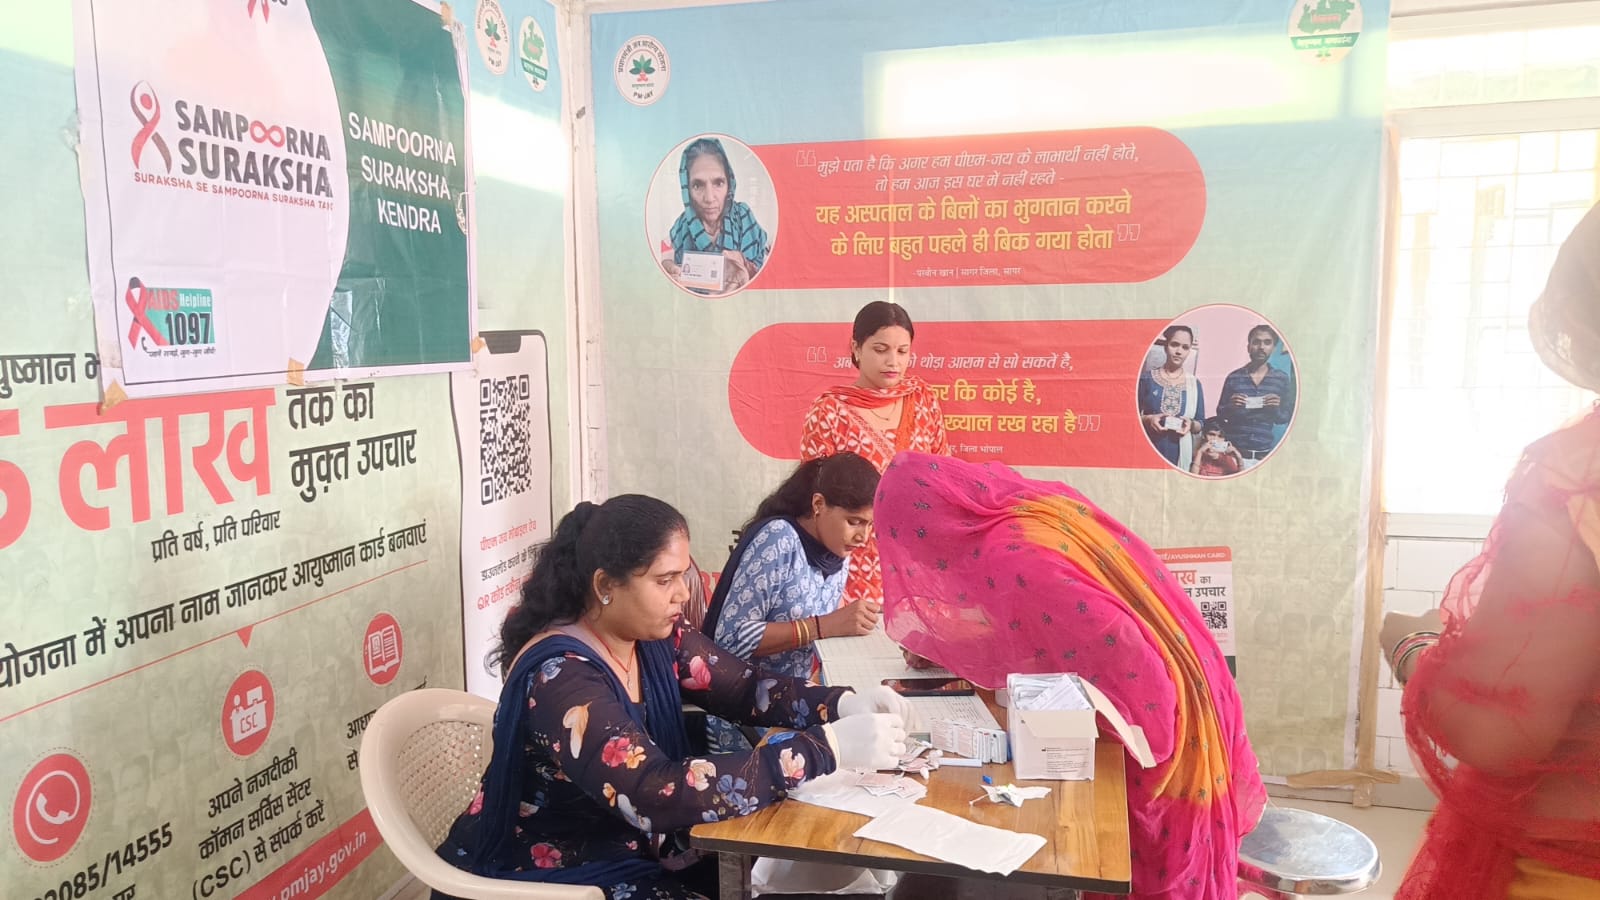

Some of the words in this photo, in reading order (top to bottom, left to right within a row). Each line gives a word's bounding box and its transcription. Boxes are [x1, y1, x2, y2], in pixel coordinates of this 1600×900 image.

[348, 112, 457, 166] SAMPOORNA
[178, 138, 333, 198] SURAKSHA
[817, 156, 841, 177] मुझे
[843, 159, 863, 173] पता
[866, 153, 876, 172] है
[878, 154, 896, 172] कि
[899, 156, 929, 170] अगर
[931, 155, 952, 169] हम
[954, 150, 1014, 168] पीएम-जय
[1017, 147, 1032, 165] के
[1035, 144, 1083, 164] लाभार्थी
[1112, 141, 1139, 163] होते,
[134, 172, 193, 190] SURAKSHA
[196, 181, 208, 193] SE
[212, 184, 270, 201] SAMPOORNA
[272, 193, 315, 208] SURAKSHA
[361, 155, 451, 200] SURAKSHA
[875, 174, 889, 192] तो
[891, 177, 911, 191] हम
[914, 176, 940, 190] आज
[944, 174, 963, 190] इस
[967, 174, 984, 188] घर
[986, 170, 1000, 187] में
[1029, 167, 1057, 185] रहते
[377, 198, 442, 234] KENDRA
[815, 206, 841, 225] यह
[845, 203, 914, 223] अस्पताल
[918, 196, 937, 222] के
[941, 194, 980, 221] बिलों
[984, 199, 1009, 219] का
[1013, 197, 1081, 224] भुगतान
[1085, 188, 1132, 215] करने
[831, 231, 849, 256] के
[853, 230, 885, 256] लिए
[889, 235, 924, 261] बहुत
[928, 228, 968, 255] पहले
[972, 227, 989, 254] ही
[994, 226, 1031, 252] बिक
[1035, 231, 1073, 251] गया
[1077, 223, 1114, 250] होता
[180, 293, 211, 308] Helpline
[165, 312, 211, 346] 1097
[920, 352, 945, 371] थोड़ा
[948, 355, 984, 369] आराम
[988, 352, 1001, 369] से
[1003, 352, 1019, 369] सो
[286, 386, 336, 429] तक
[342, 382, 375, 421] का
[954, 378, 978, 401] कि
[982, 377, 1019, 405] कोई
[1022, 377, 1042, 405] है,
[943, 414, 993, 432] ख्याल
[997, 415, 1028, 433] रख
[1031, 415, 1060, 433] रहा
[1063, 408, 1078, 434] है
[44, 387, 277, 531] लाख
[357, 429, 417, 475] उपचार
[151, 529, 179, 563] प्रति
[182, 521, 210, 552] वर्ष,
[213, 515, 237, 546] प्रति
[241, 509, 281, 537] परिवार
[83, 616, 107, 656] में
[114, 603, 175, 648] अपना
[180, 588, 220, 625] नाम
[224, 567, 288, 608] जानकर
[292, 545, 355, 587] आयुष्मान
[359, 527, 385, 563] कार्ड
[387, 518, 427, 552] बनवाएं
[1194, 586, 1226, 598] उपचार
[1200, 575, 1211, 585] का
[477, 594, 490, 610] QR
[240, 711, 258, 734] CSC
[208, 777, 243, 818] अपने
[246, 747, 298, 795] नजदीकी
[199, 818, 245, 860] कॉमन
[248, 794, 284, 831] सर्विस
[286, 778, 311, 807] सेंटर
[193, 850, 251, 900] (CSC)
[253, 836, 267, 863] से
[269, 810, 302, 853] संपर्क
[304, 799, 326, 829] करें
